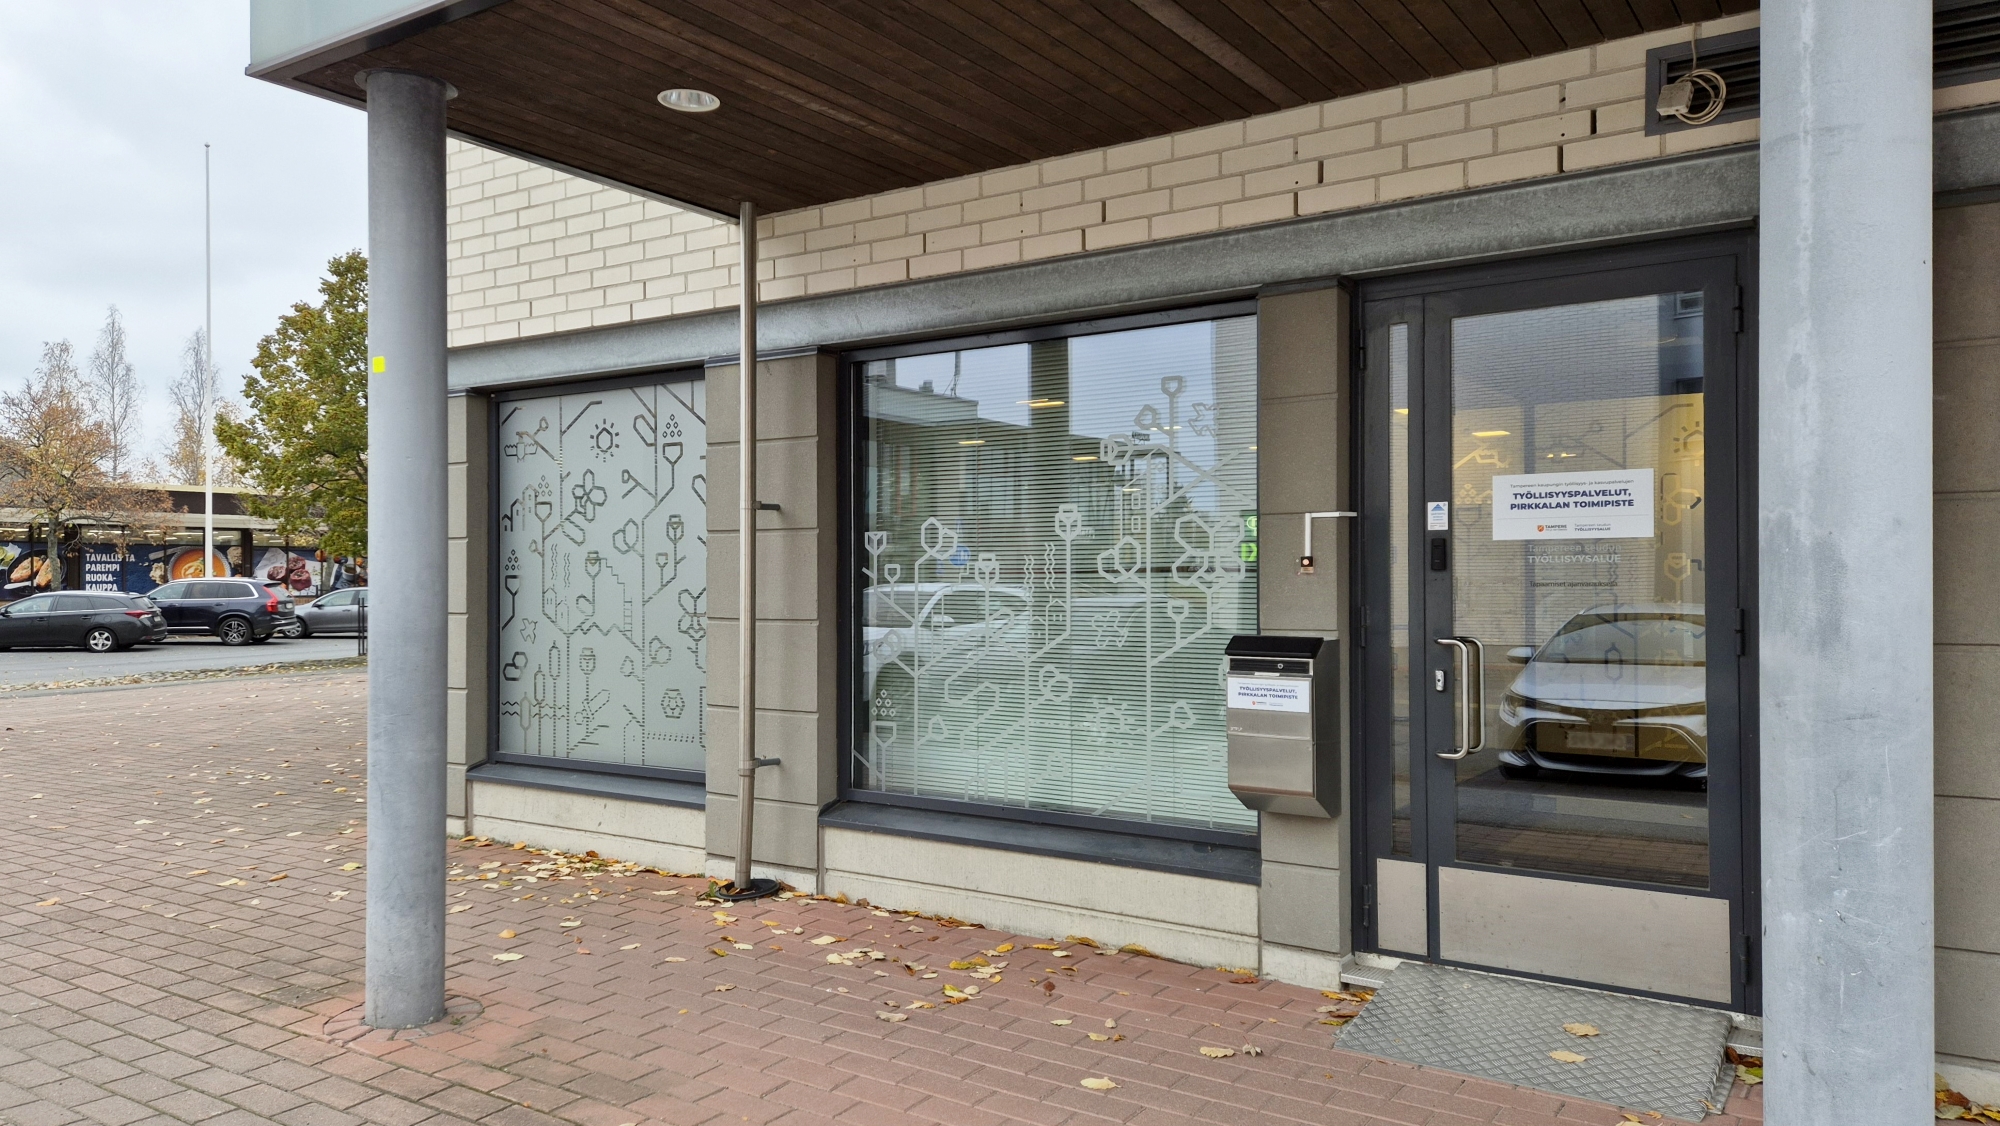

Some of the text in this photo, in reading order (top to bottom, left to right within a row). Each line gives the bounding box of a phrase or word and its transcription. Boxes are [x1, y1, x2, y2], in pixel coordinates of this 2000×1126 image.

[1512, 488, 1631, 500] TYÖLLISYYSPALVELUT,
[1510, 499, 1634, 510] PIRKKALAN TOIMIPISTE
[1528, 544, 1582, 552] Tampereen
[1528, 554, 1622, 564] TYÖLLISYYSALUE
[86, 564, 120, 572] PAREMPI
[86, 574, 116, 582] RUOKA-
[86, 584, 118, 592] KAUPPA
